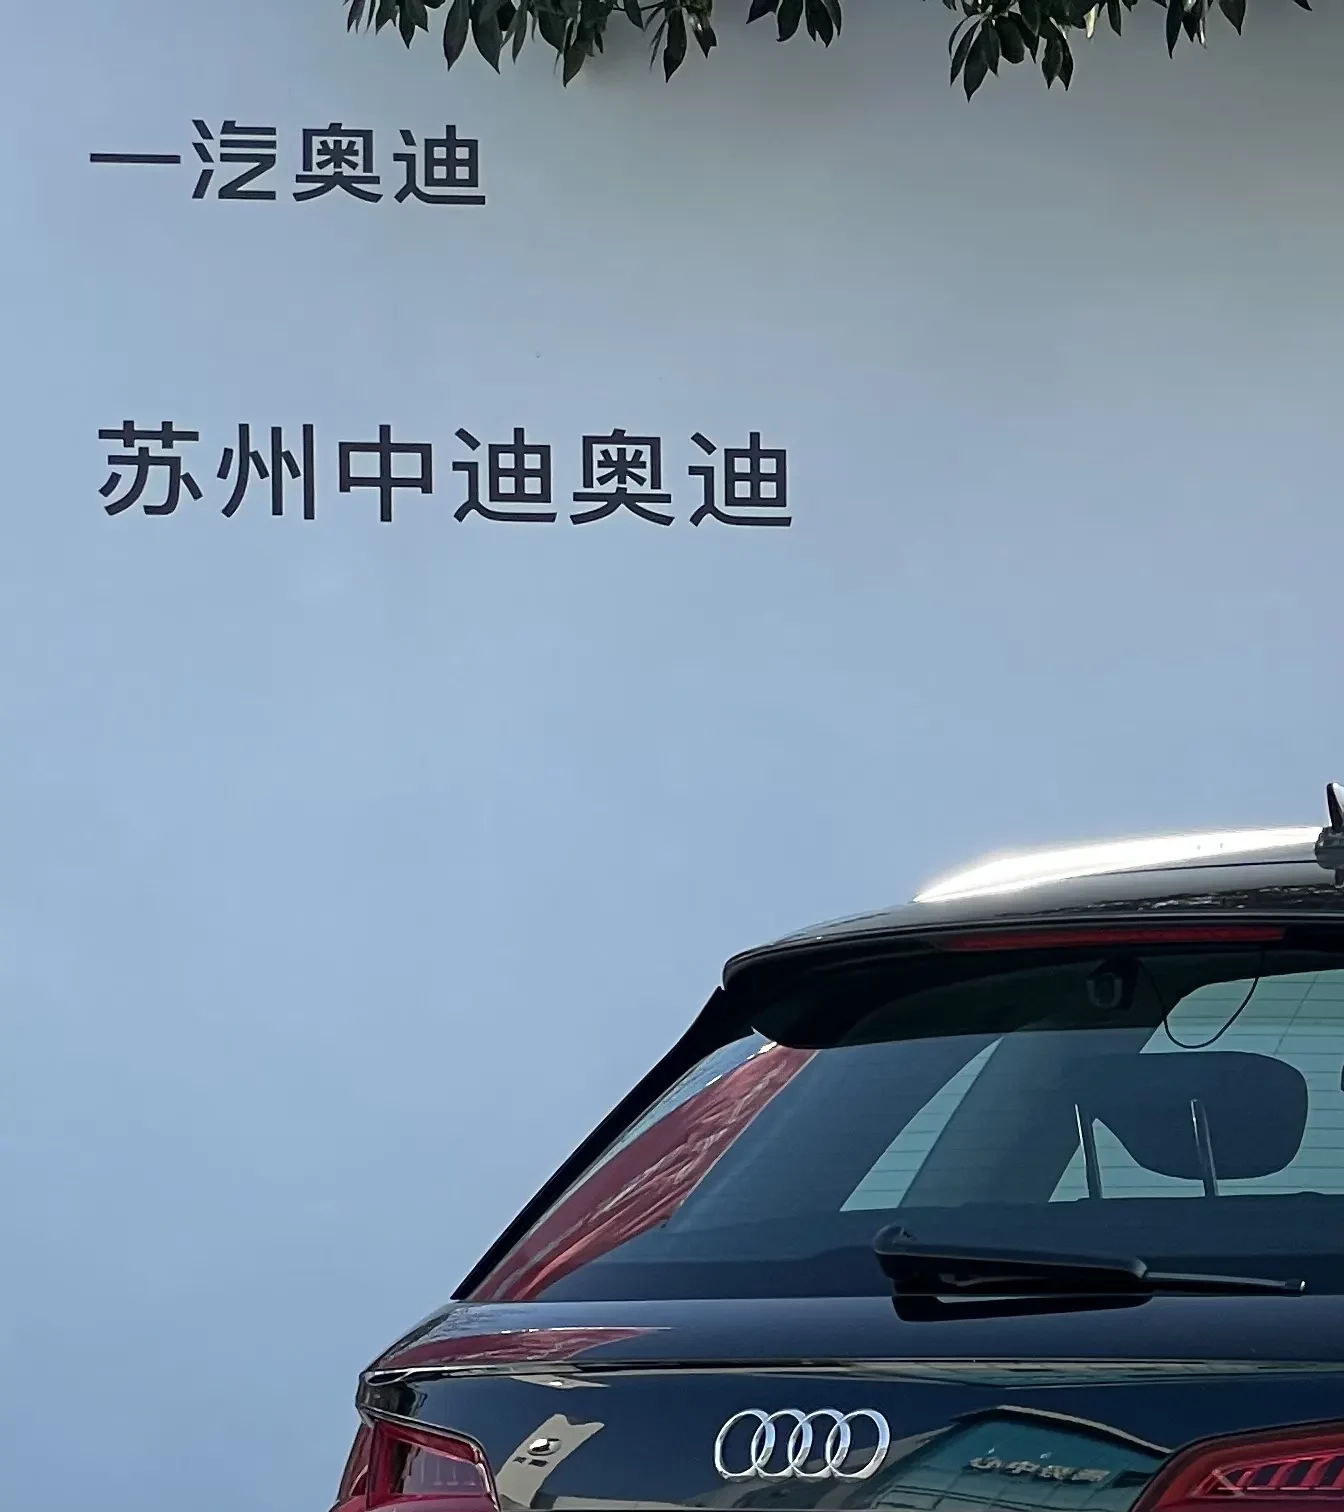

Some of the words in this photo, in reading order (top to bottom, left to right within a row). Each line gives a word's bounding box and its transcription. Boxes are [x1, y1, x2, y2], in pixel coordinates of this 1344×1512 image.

[90, 119, 486, 206] 一汽奥迪
[98, 420, 792, 528] 苏州中迪奥迪
